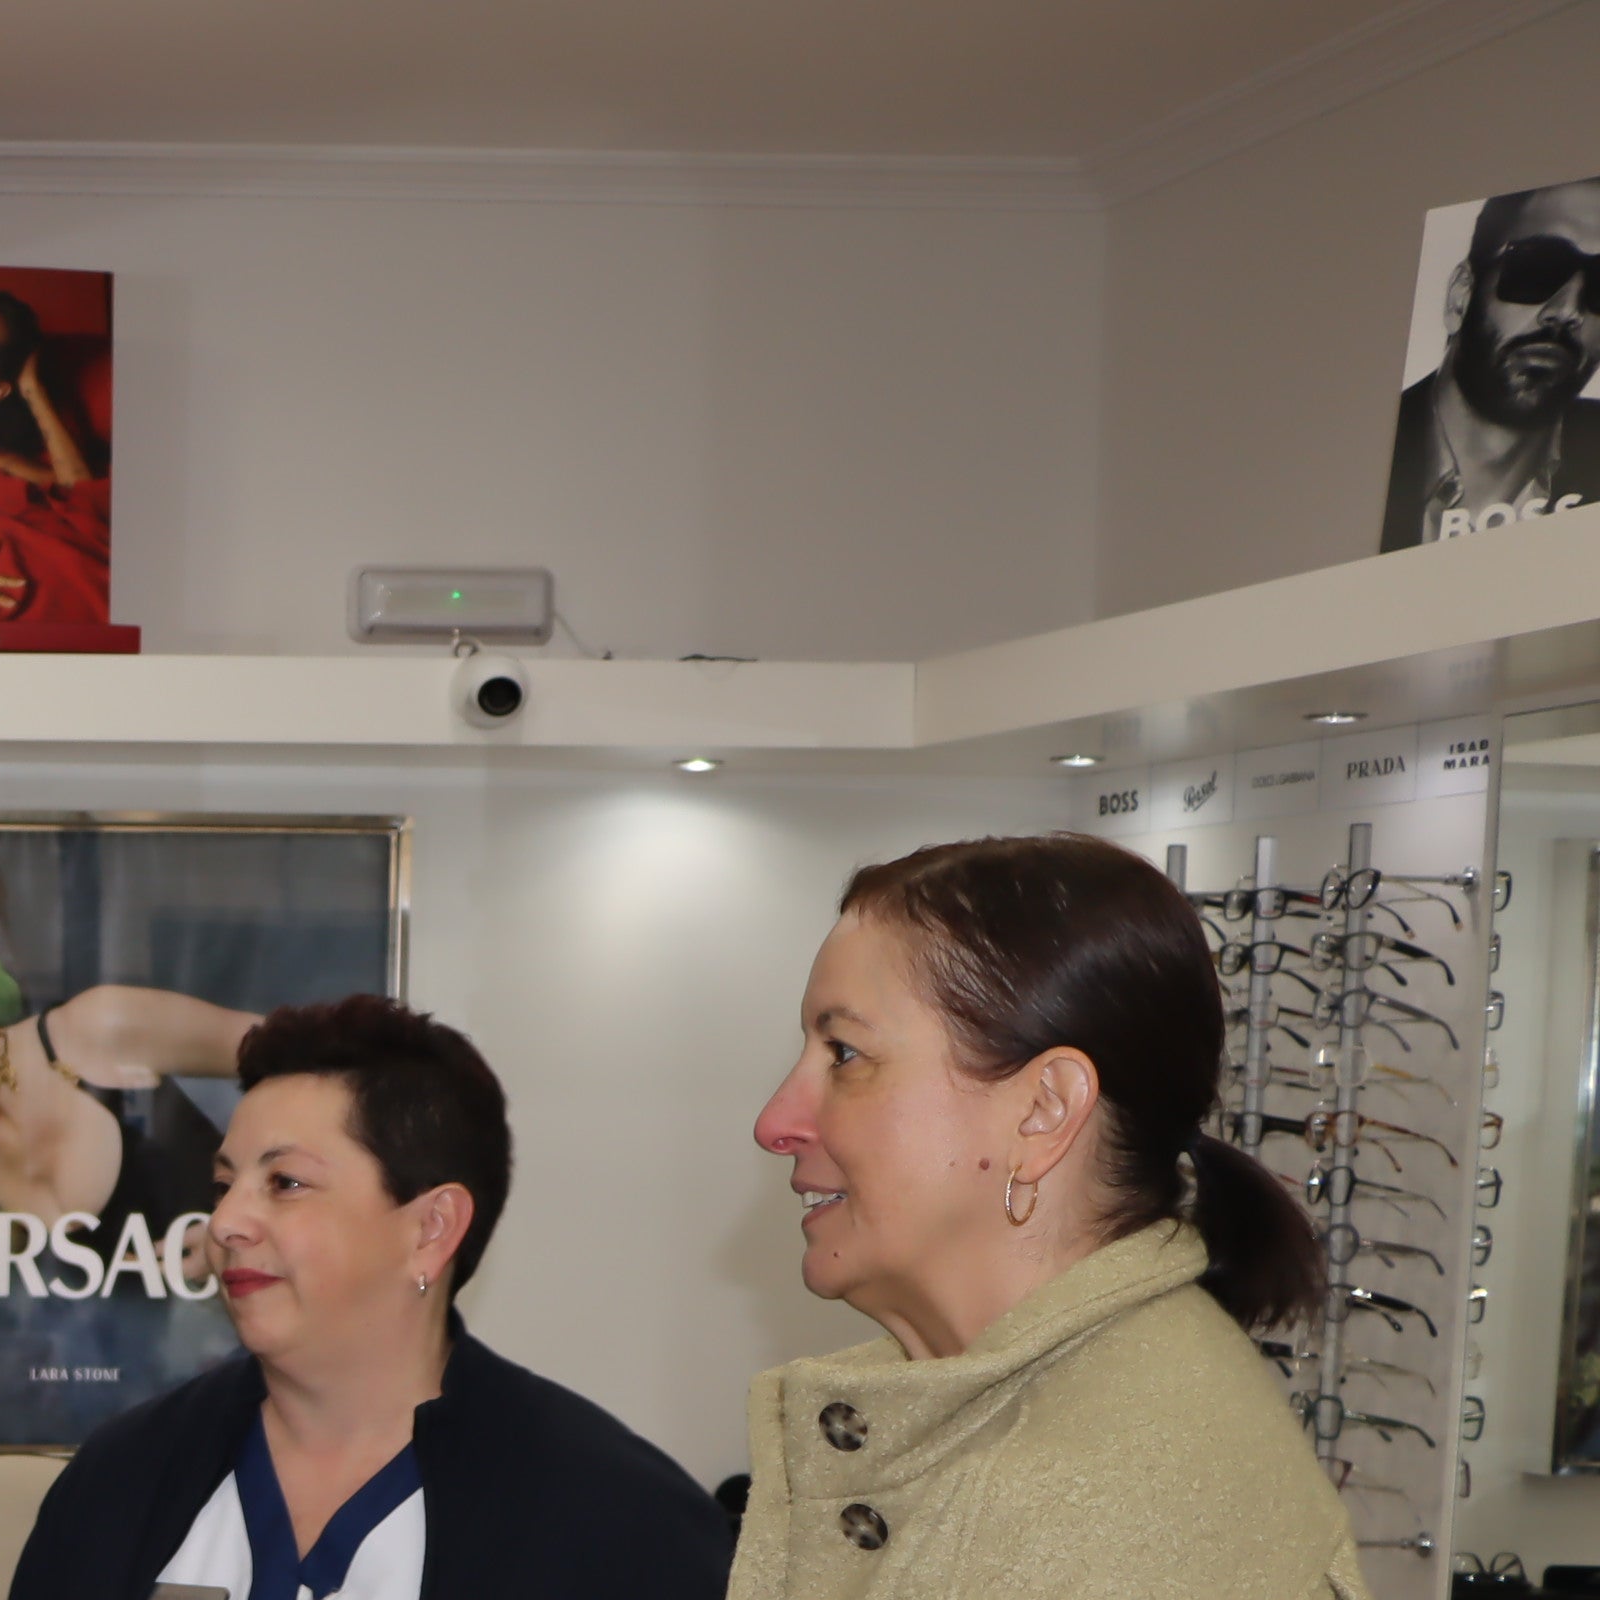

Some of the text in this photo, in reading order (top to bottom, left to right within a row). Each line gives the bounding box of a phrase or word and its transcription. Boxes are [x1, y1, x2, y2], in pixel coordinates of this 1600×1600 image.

[1449, 739, 1489, 755] ISAB
[1347, 755, 1406, 779] PRADA
[1443, 754, 1490, 770] MARA
[1098, 789, 1139, 817] BOSS
[30, 1367, 121, 1381] LARA STONE
